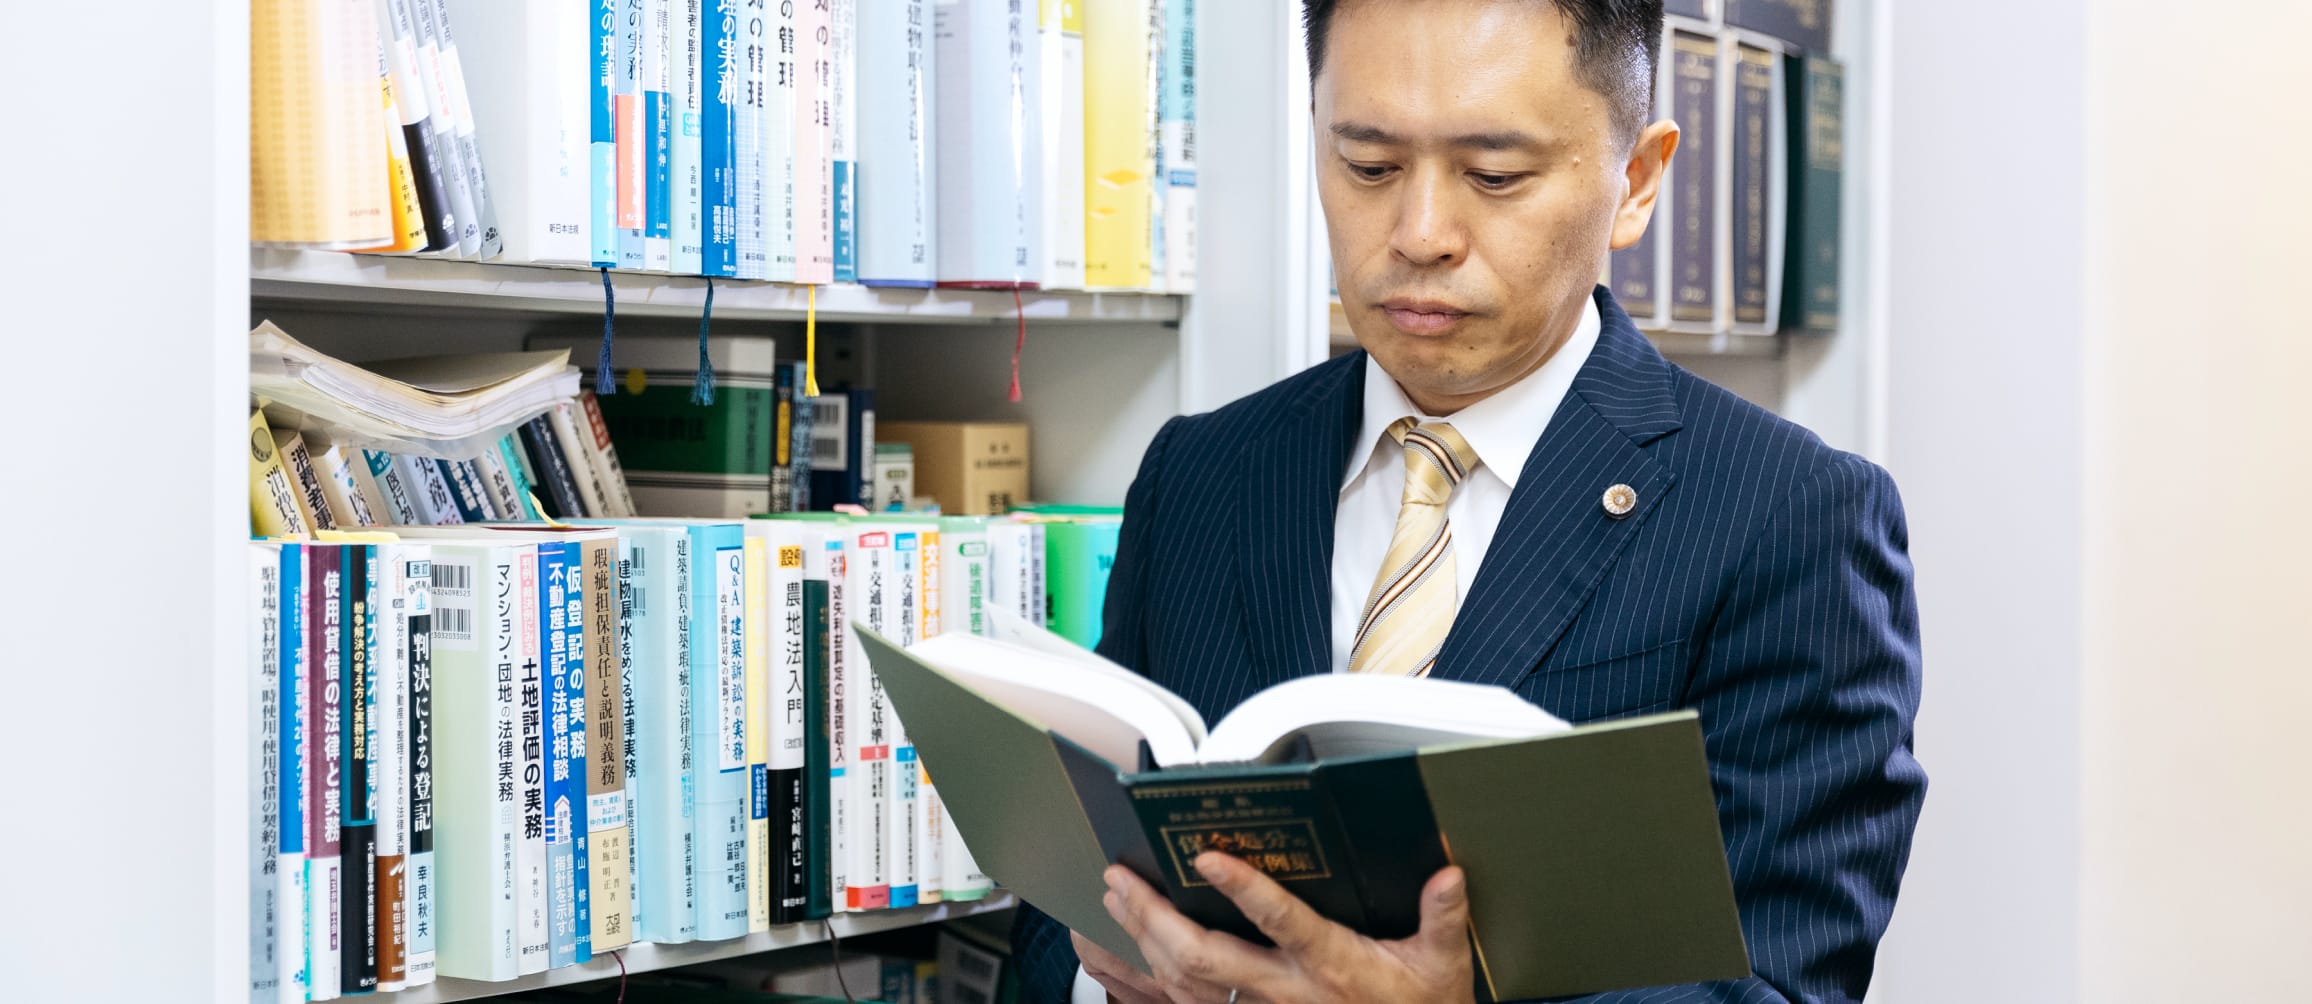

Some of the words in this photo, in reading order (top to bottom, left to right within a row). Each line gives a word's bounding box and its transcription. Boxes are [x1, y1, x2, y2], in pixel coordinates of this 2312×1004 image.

[549, 223, 579, 235] 新日本法規
[323, 571, 341, 843] 使用貸借の法律と実務
[412, 632, 432, 833] 判決による登記
[497, 563, 514, 803] マンション・団地の法律実務
[521, 657, 543, 840] 土地評価の実務
[548, 563, 569, 782] 不動産登記の法律相談
[566, 566, 585, 759] 仮登記の実務
[594, 547, 616, 787] 瑕疵担保責任と説明義務
[785, 581, 802, 725] 農地法入門
[417, 864, 429, 938] 幸良秋夫
